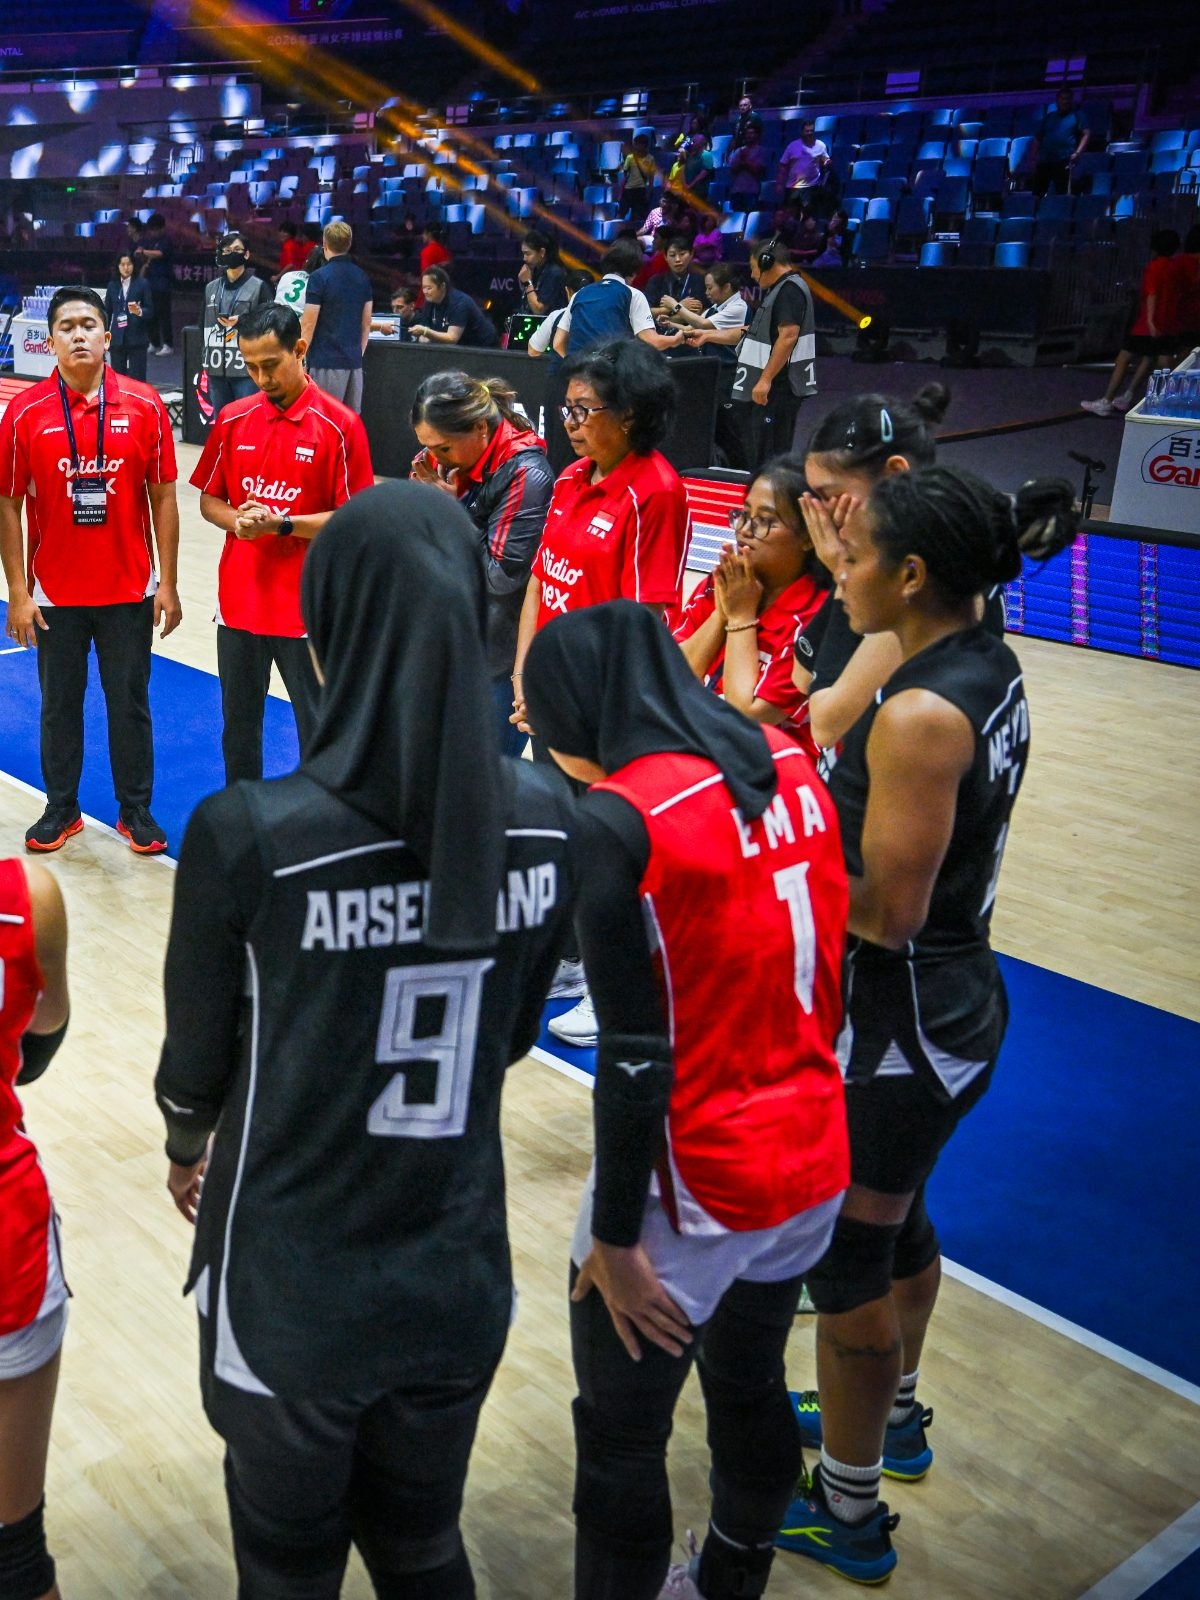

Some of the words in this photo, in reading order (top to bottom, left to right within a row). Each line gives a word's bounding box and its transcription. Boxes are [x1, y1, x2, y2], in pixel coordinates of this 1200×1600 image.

[27, 329, 47, 340] 百岁山
[202, 349, 246, 370] 1095
[732, 366, 748, 391] 2
[805, 362, 817, 386] 1
[58, 454, 125, 478] Vidio
[295, 454, 313, 464] INA
[242, 474, 302, 502] Vidio
[586, 525, 606, 539] INA
[773, 860, 817, 1016] 1
[366, 957, 496, 1138] 9
